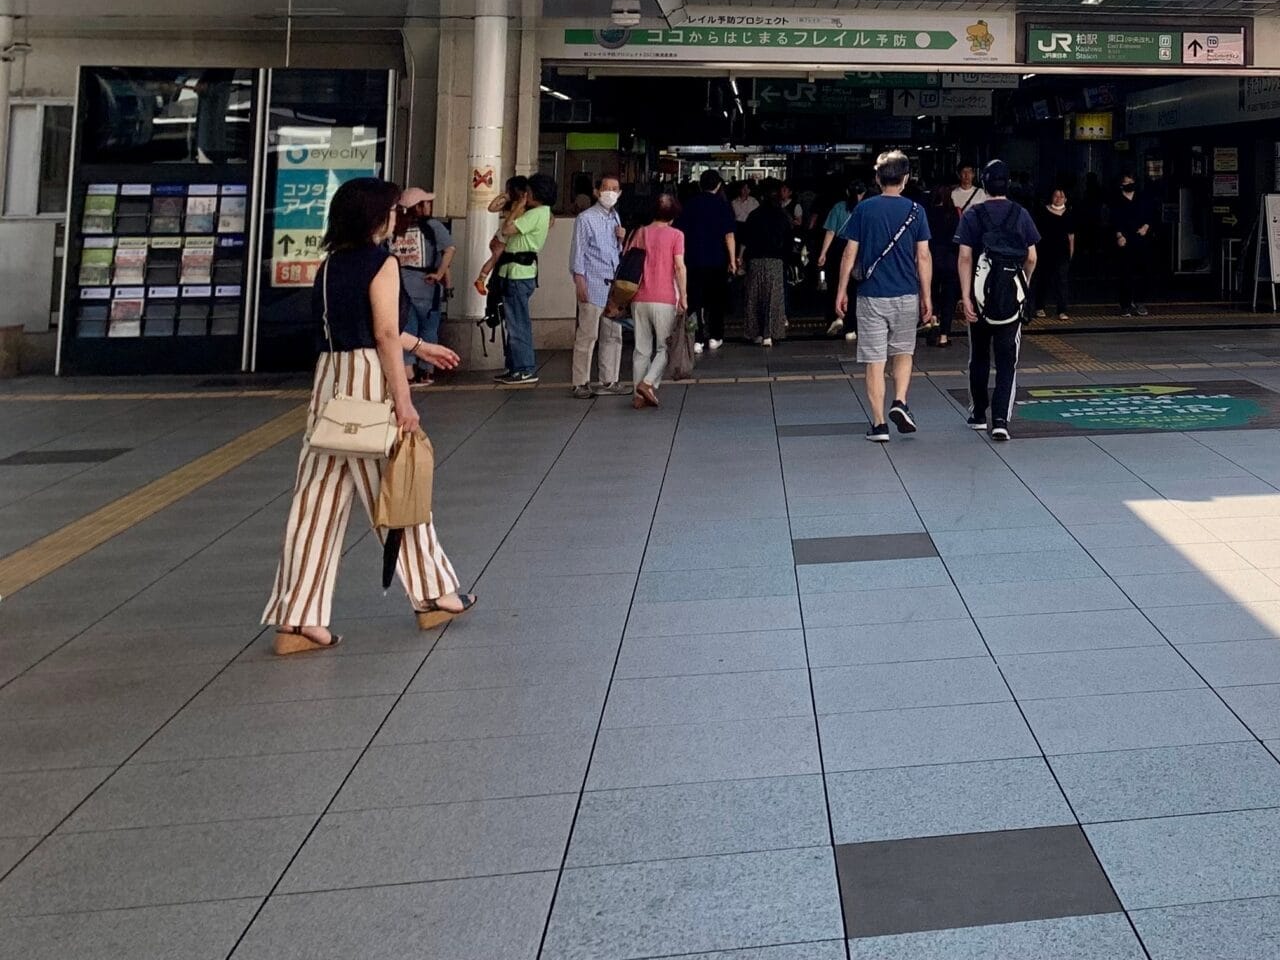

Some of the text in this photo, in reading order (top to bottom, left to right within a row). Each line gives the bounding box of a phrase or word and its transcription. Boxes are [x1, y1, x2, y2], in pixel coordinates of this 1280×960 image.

[646, 30, 908, 48] ココからはじまるフレイル予防
[1037, 32, 1073, 52] JR
[1076, 33, 1098, 45] 柏駅
[310, 146, 368, 162] eyecity
